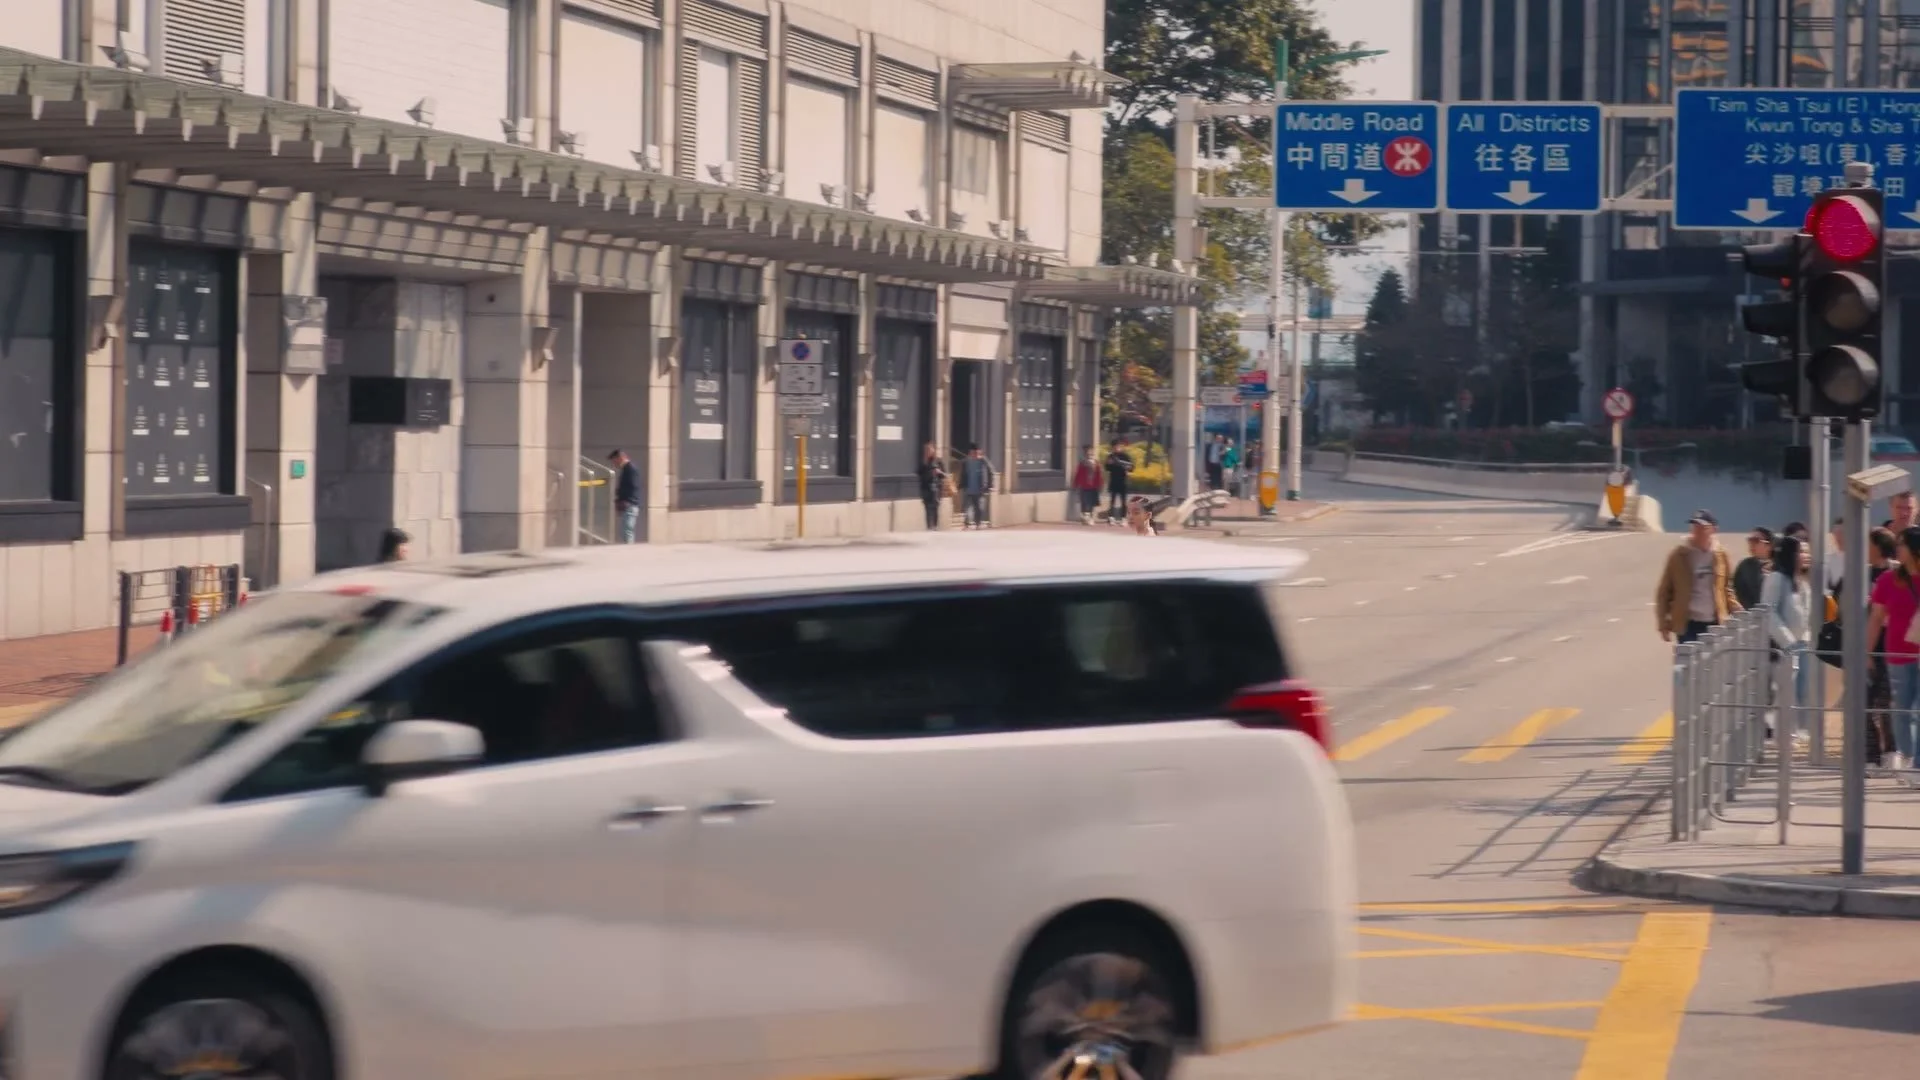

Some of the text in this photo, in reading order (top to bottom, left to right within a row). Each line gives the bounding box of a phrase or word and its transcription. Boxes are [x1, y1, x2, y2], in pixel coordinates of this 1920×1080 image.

[1707, 96, 1748, 113] Tsim
[1756, 97, 1789, 113] Sha
[1795, 97, 1831, 113] Tsui
[1285, 112, 1424, 131] Middle Road
[1456, 113, 1591, 133] All Districts
[1745, 117, 1794, 133] Kwun
[1800, 117, 1844, 137] Tong
[1851, 118, 1863, 133] &
[1870, 118, 1904, 134] Sha
[1287, 142, 1383, 171] 中間道
[1475, 143, 1571, 172] 往各區
